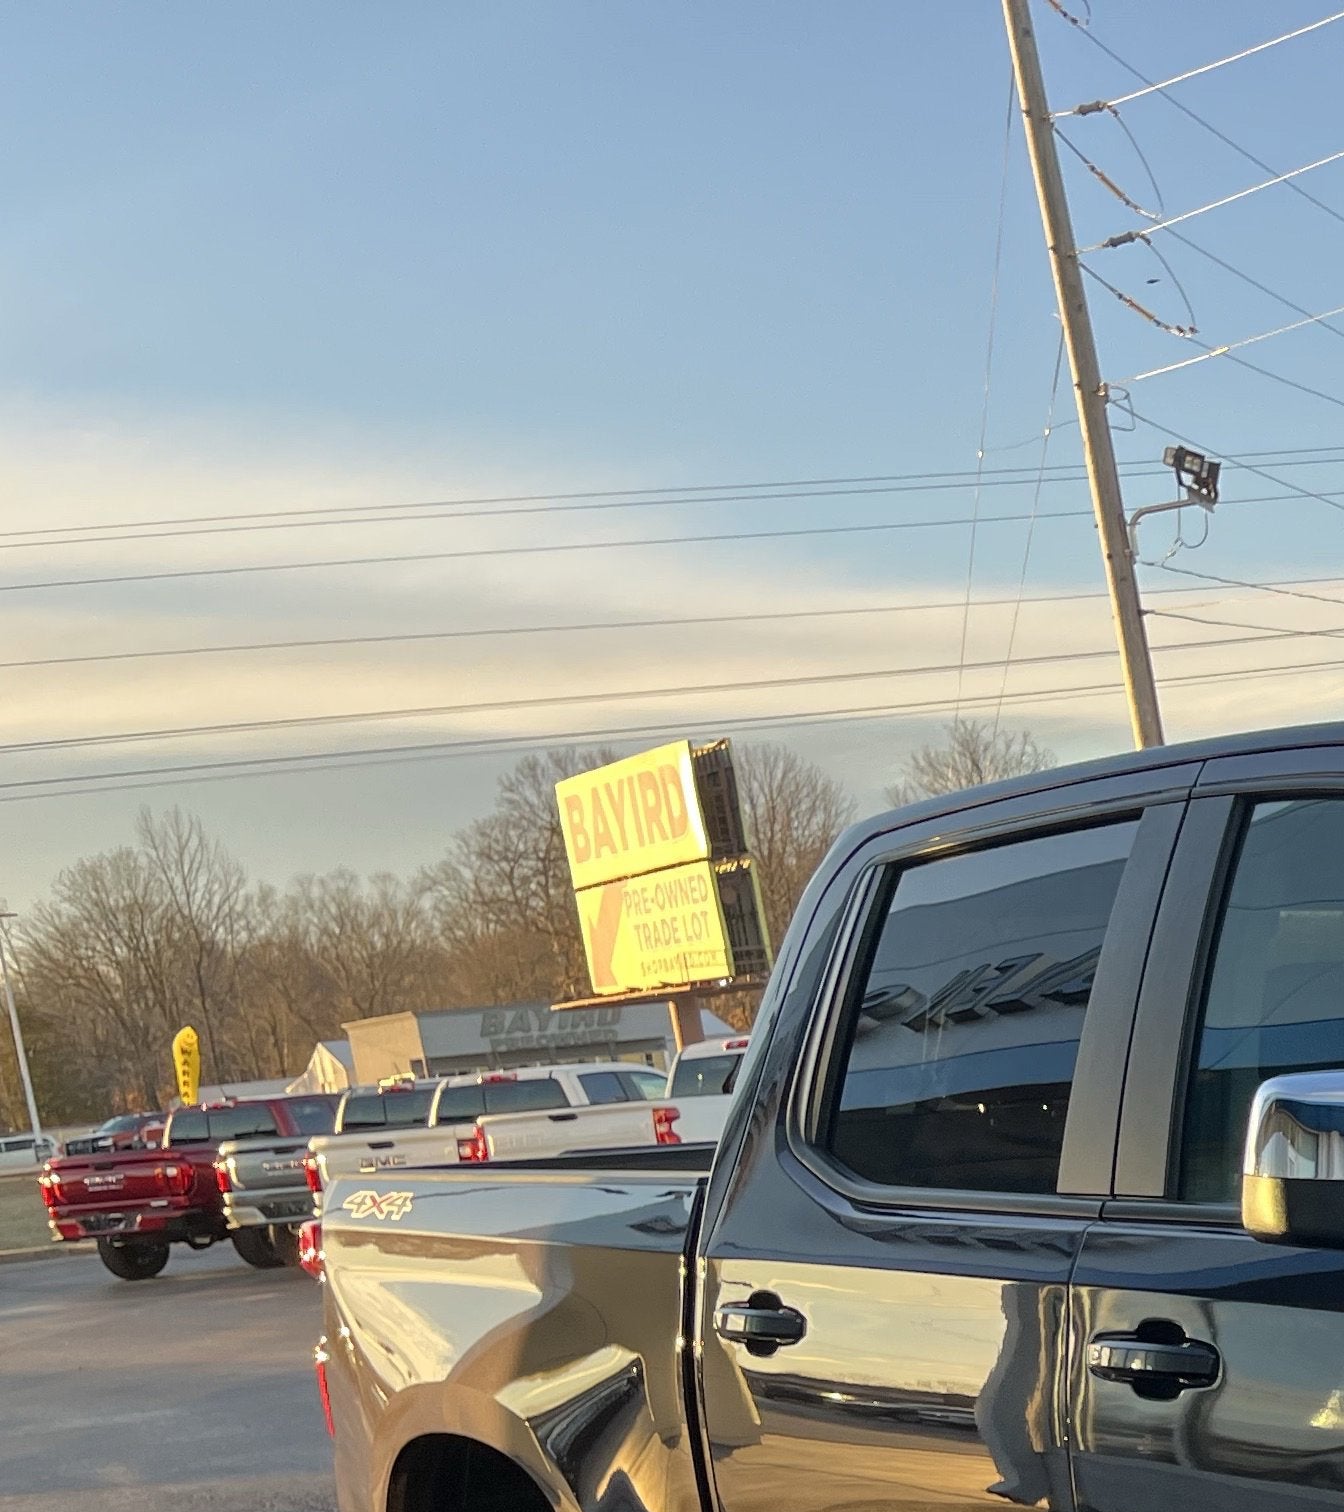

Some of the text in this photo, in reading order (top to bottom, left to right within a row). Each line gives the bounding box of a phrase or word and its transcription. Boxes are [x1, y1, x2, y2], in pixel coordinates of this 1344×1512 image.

[565, 764, 689, 864] BAYIRD
[623, 874, 709, 917] PRE-OWNED
[633, 911, 711, 952] TRADE LOT
[480, 1008, 622, 1037] BAYIRD
